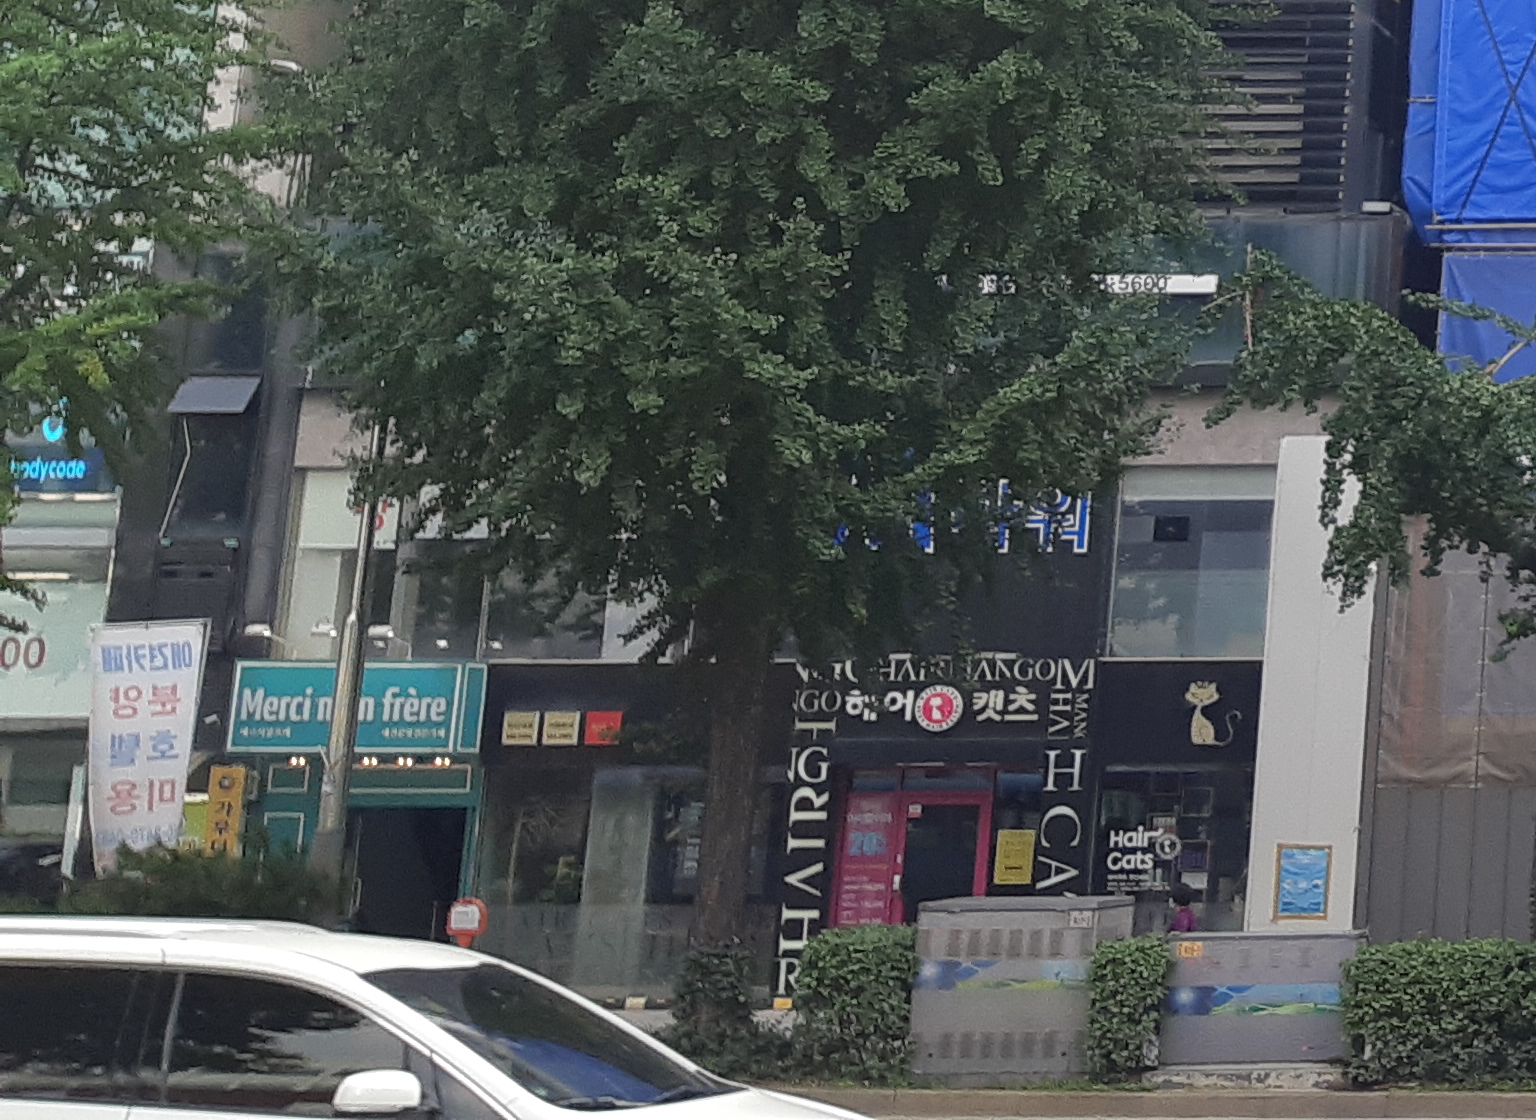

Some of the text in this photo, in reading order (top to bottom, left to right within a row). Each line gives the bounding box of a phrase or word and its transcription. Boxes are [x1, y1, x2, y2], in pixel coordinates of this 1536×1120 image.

[239, 686, 313, 723] Merci
[1108, 825, 1165, 849] Hair
[1106, 850, 1155, 871] Cats
